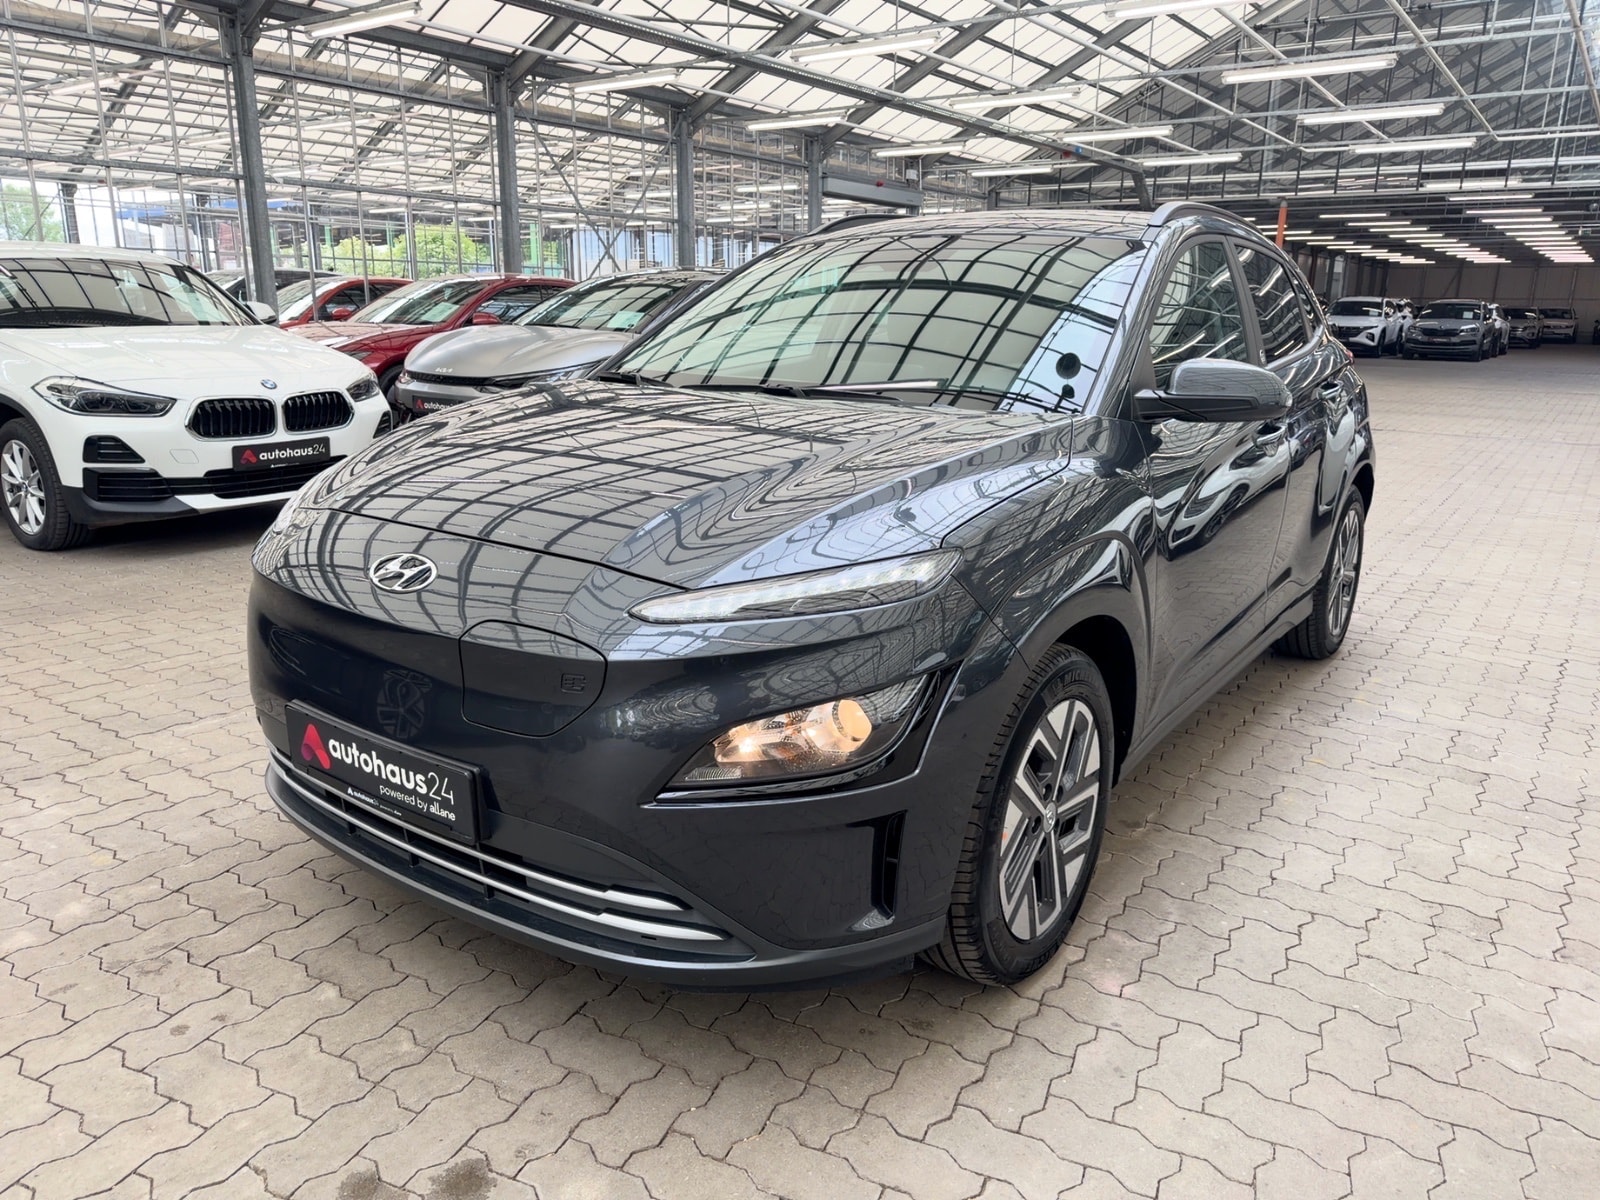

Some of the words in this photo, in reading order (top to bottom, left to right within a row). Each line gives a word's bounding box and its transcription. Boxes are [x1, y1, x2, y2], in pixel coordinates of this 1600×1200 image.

[424, 402, 453, 410] autohau
[259, 444, 325, 460] autohaus24
[328, 738, 454, 805] autohaus24
[379, 785, 415, 806] powered
[416, 797, 428, 812] by
[429, 801, 456, 821] allane
